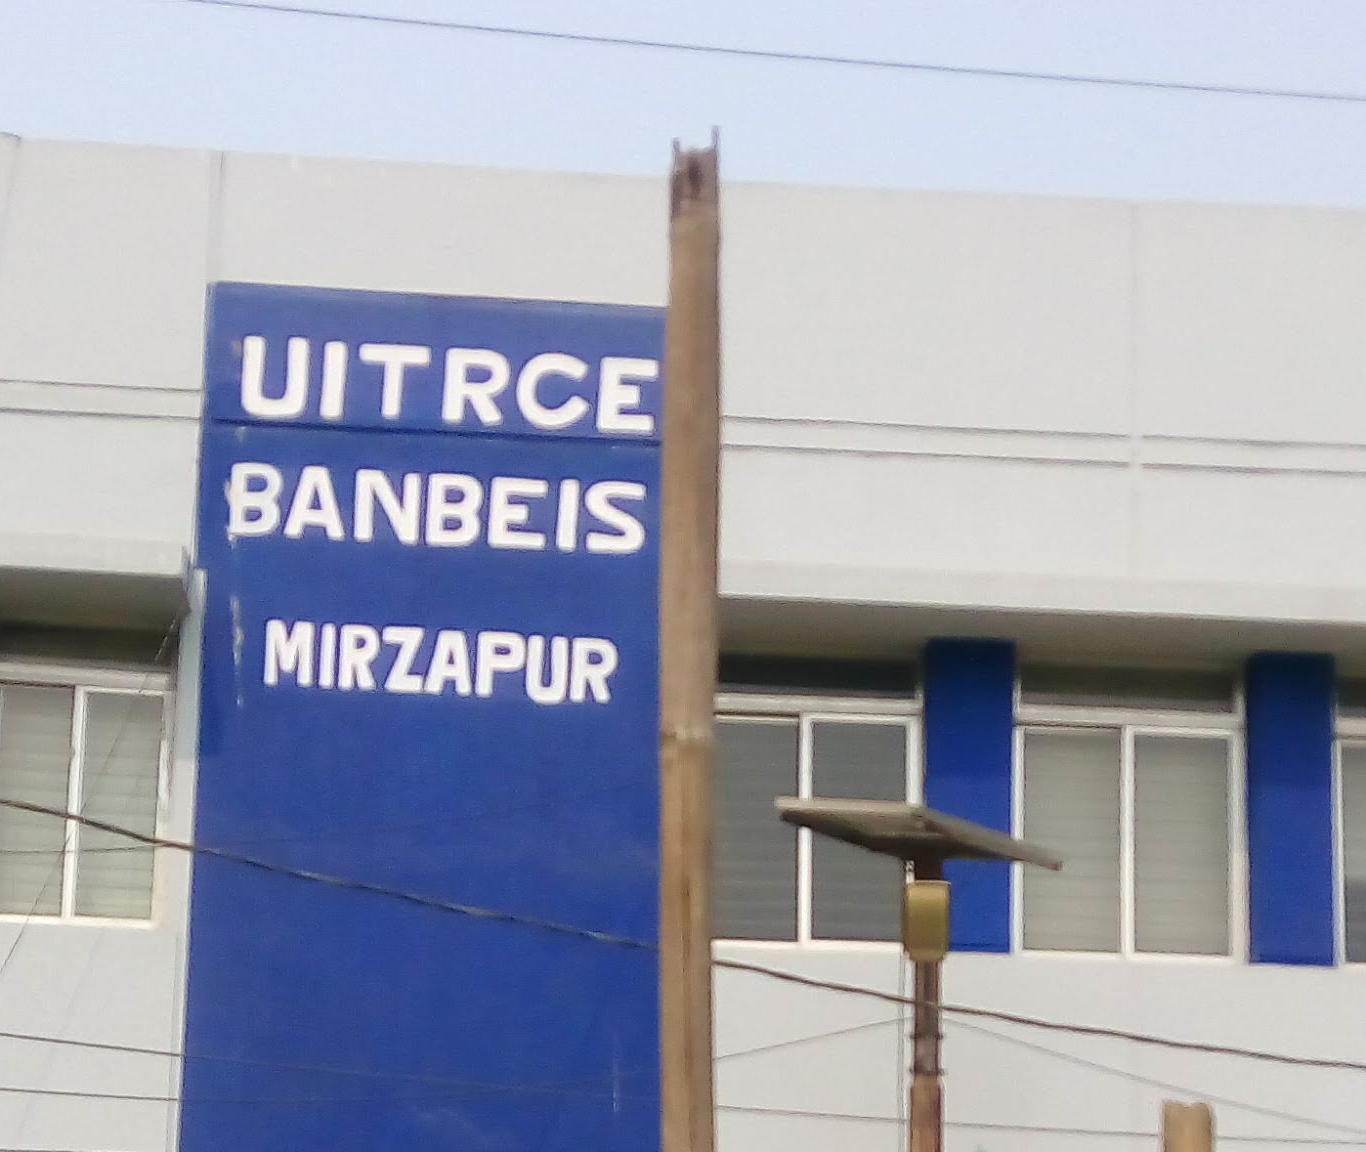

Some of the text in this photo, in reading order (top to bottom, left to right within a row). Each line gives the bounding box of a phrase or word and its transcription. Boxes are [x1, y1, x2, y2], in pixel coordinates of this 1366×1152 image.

[241, 335, 659, 434] UITRCE
[228, 461, 647, 554] BANBEIS
[264, 618, 618, 705] MIRZAPUR
